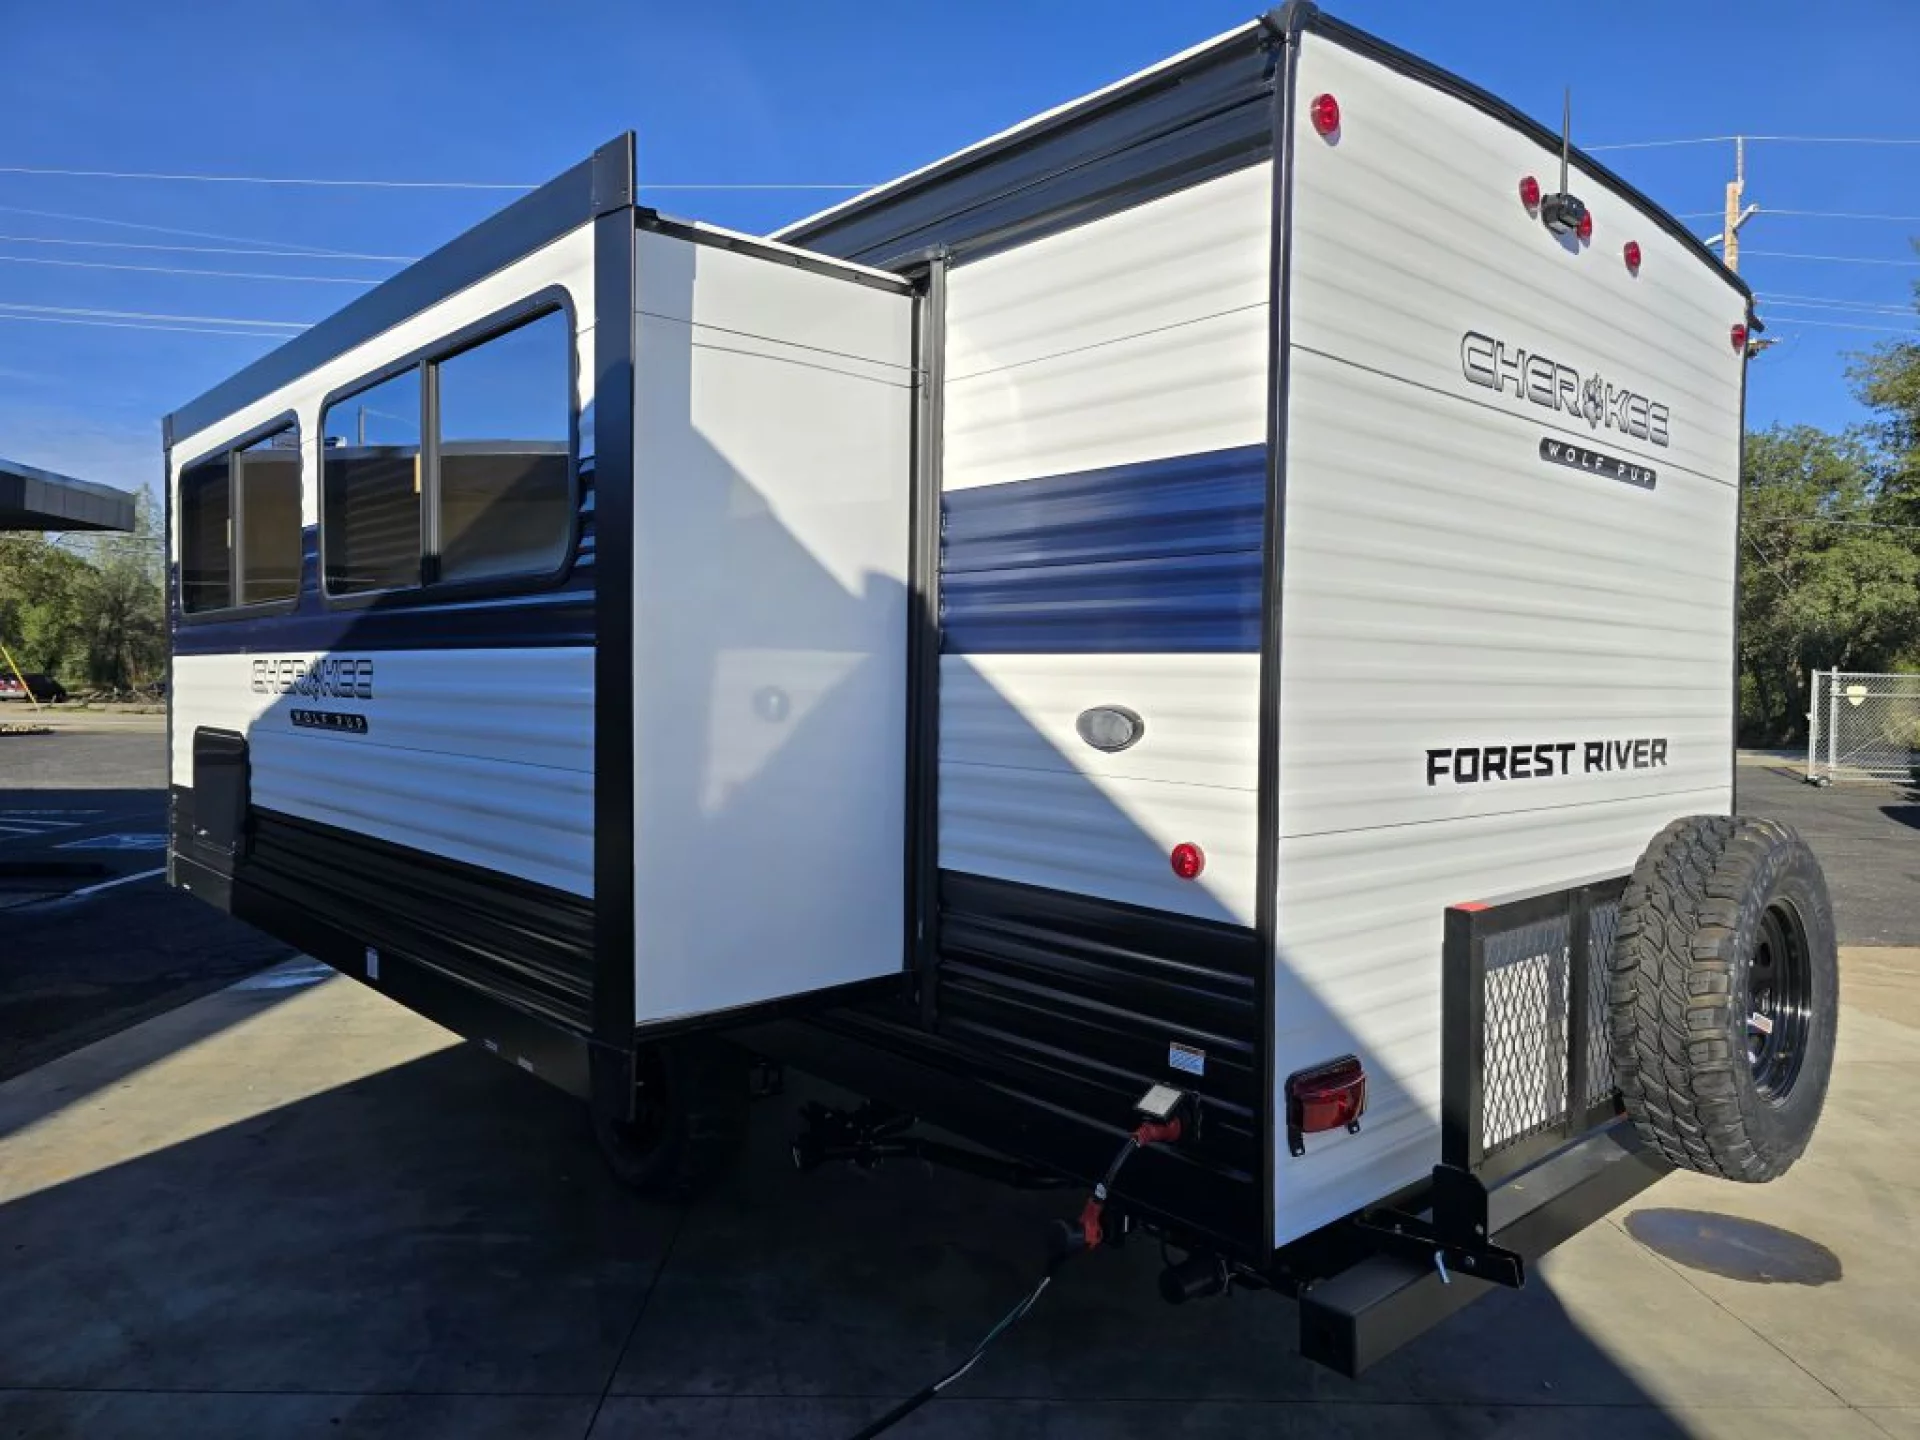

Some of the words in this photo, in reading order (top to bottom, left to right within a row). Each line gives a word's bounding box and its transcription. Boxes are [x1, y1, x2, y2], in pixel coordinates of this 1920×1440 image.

[1461, 330, 1669, 448] CHEROKEE
[1548, 441, 1604, 470] WOLF
[1617, 463, 1652, 485] PUP
[253, 659, 373, 701] CHEROKEE
[293, 710, 327, 726] WOLF
[335, 714, 363, 730] PUP
[1425, 742, 1576, 786] FOREST
[1584, 738, 1668, 773] RIVER
